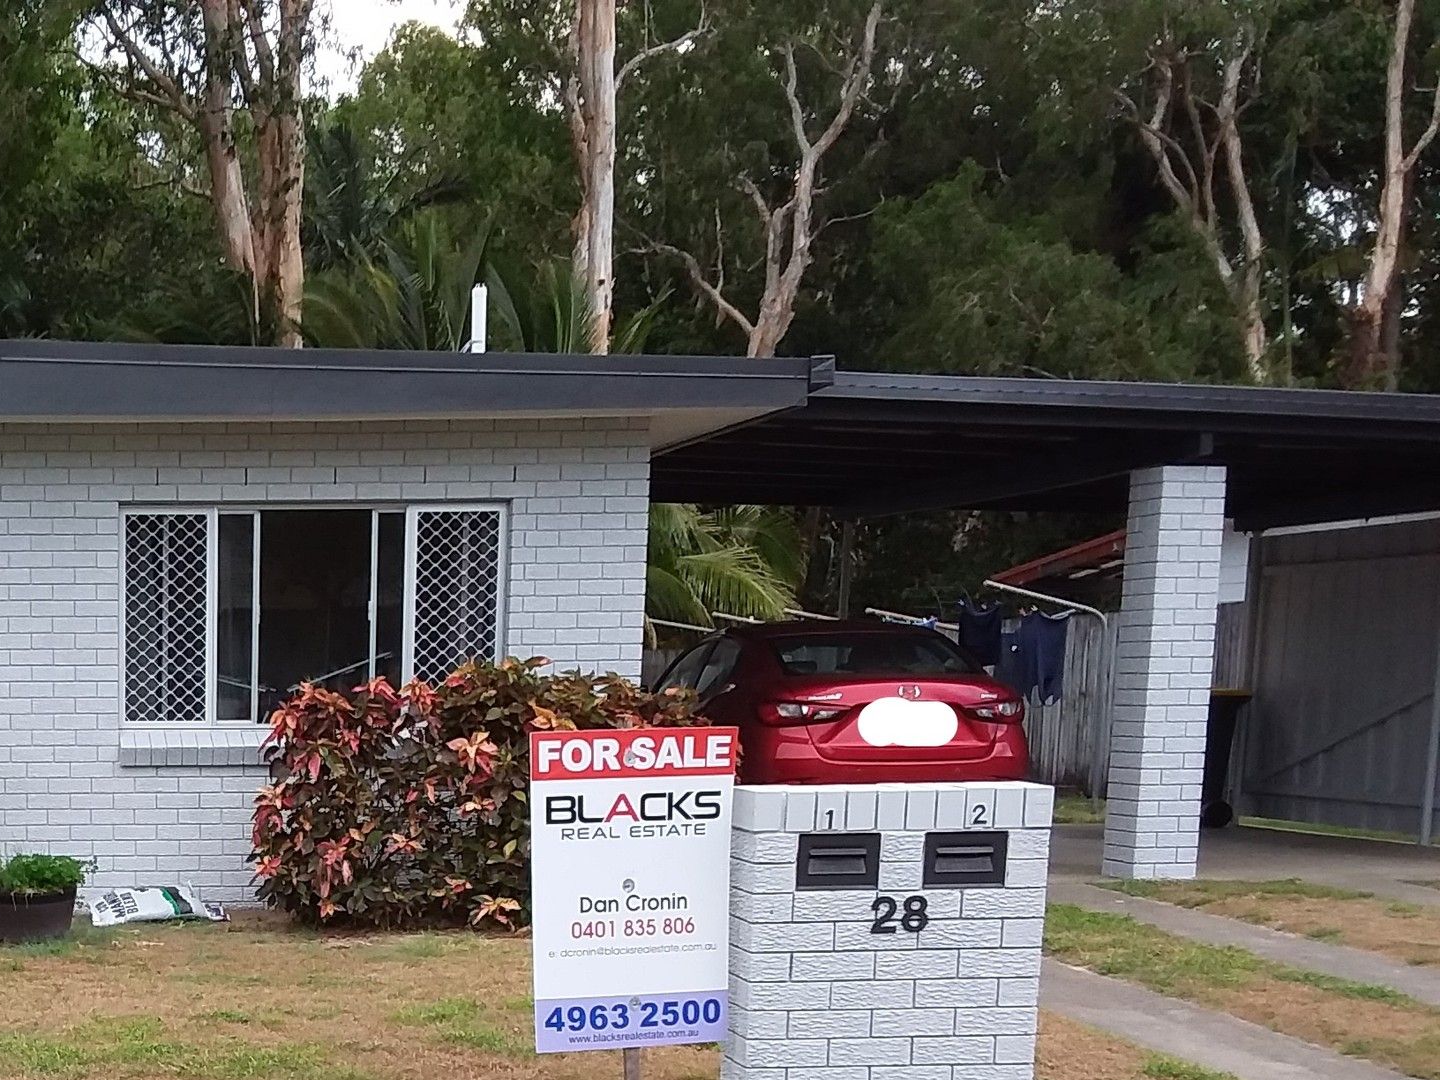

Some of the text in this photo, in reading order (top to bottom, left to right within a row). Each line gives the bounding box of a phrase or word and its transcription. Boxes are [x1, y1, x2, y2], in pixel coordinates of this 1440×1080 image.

[538, 735, 732, 773] FOR SALE
[545, 791, 721, 825] BLACKS
[972, 804, 988, 825] 2
[824, 810, 835, 830] 1
[561, 823, 706, 841] REAL ESTATE
[580, 893, 688, 913] Dan Cronin
[870, 895, 928, 934] 28
[571, 917, 695, 939] 0401 835 806
[544, 999, 721, 1032] 4963 2500
[568, 1029, 699, 1044] www.blacksrealestate.com.au
